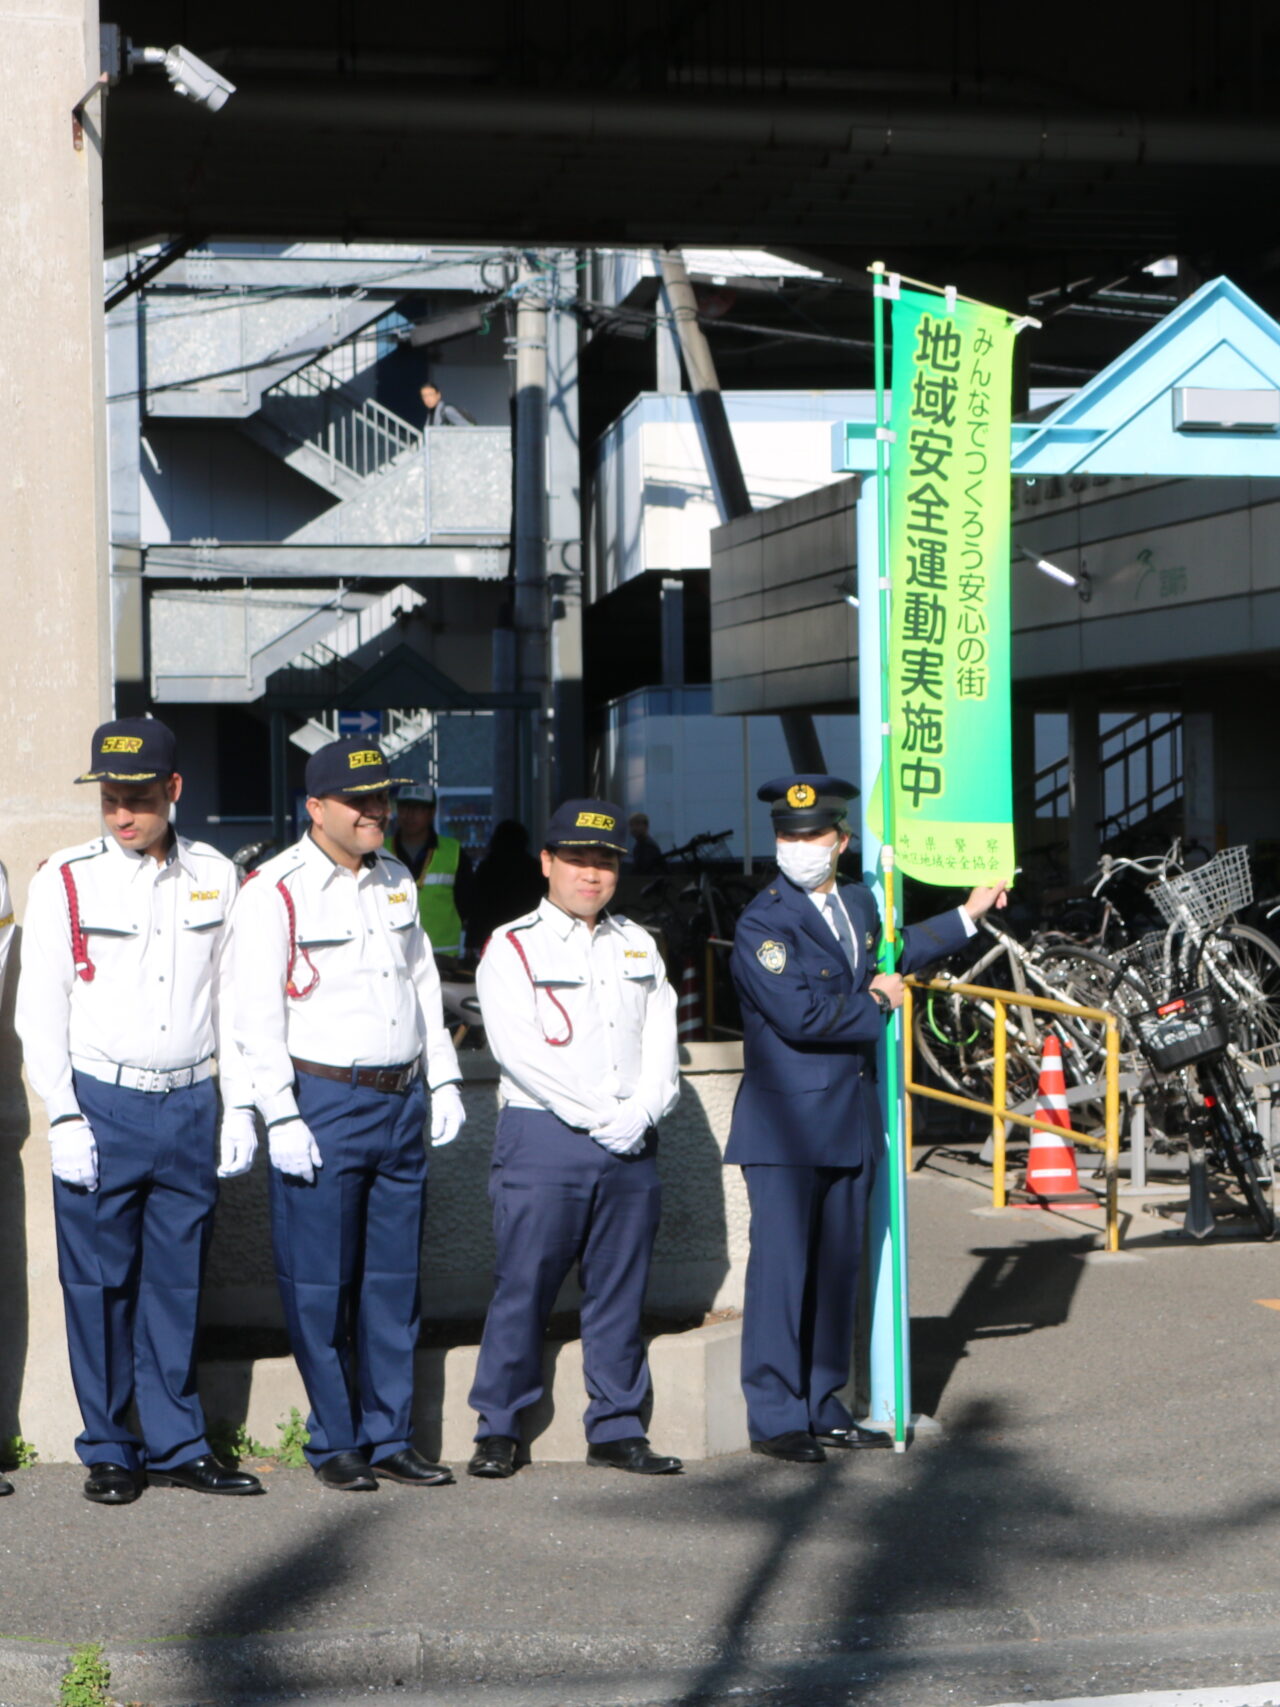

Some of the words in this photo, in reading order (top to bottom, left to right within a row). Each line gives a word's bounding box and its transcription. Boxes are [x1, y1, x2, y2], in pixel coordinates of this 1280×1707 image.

[900, 316, 961, 808] 地域安全運動実施中
[957, 328, 994, 697] みんなでつくろう安心の街
[101, 736, 142, 752] SER
[578, 813, 614, 830] SER
